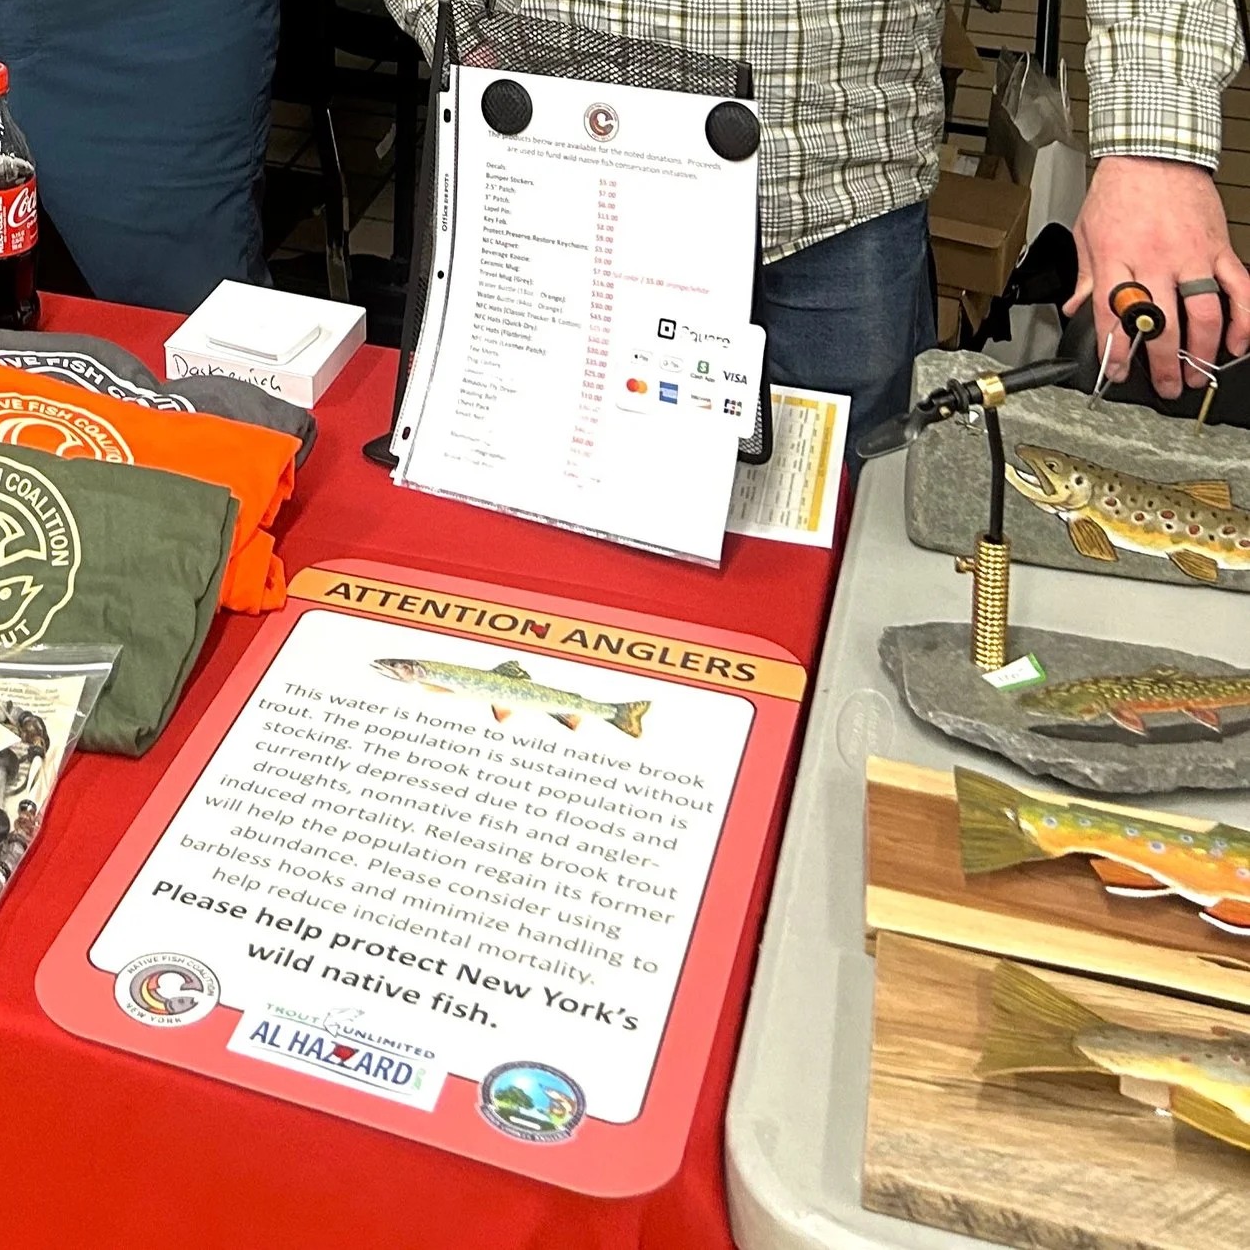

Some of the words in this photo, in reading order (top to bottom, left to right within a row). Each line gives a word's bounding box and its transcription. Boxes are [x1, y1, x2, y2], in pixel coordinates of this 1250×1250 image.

[28, 402, 73, 421] FISH
[722, 370, 747, 385] VISA
[5, 472, 69, 567] COALITION
[324, 582, 551, 639] ATTENTION
[560, 629, 757, 683] ANGLERS
[258, 698, 313, 720] trout.
[323, 711, 360, 730] The
[364, 724, 481, 758] population
[487, 749, 503, 764] is
[510, 755, 618, 790] sustained
[624, 780, 714, 812] without
[262, 720, 353, 751] stocking.
[363, 741, 400, 760] The
[406, 752, 470, 778] brook
[476, 769, 532, 792] trout
[538, 785, 663, 825] population
[670, 814, 689, 831] is
[284, 682, 322, 701] This
[330, 694, 389, 716] water
[394, 706, 409, 721] is
[415, 711, 476, 736] home
[483, 728, 504, 742] to
[512, 734, 557, 754] wild
[563, 746, 631, 771] native
[639, 762, 705, 789] brook
[219, 773, 307, 805] induced
[311, 796, 415, 834] mortality.
[424, 824, 534, 865] Releasing
[540, 852, 609, 883] brook
[617, 875, 678, 901] trout
[253, 761, 352, 795] droughts,
[360, 786, 472, 823] nonnative
[478, 813, 519, 835] fish
[526, 828, 570, 847] and
[576, 839, 660, 869] angler-
[255, 739, 351, 772] currently
[356, 758, 469, 799] depressed
[475, 791, 518, 811] due
[524, 804, 548, 818] to
[555, 809, 626, 839] floods
[632, 830, 678, 851] and
[179, 833, 271, 869] barbless
[278, 859, 346, 888] hooks
[351, 880, 397, 902] and
[402, 893, 510, 932] minimize
[517, 922, 624, 968] handling
[632, 955, 659, 974] to
[204, 794, 243, 813] will
[247, 803, 295, 826] help
[301, 817, 337, 836] the
[342, 829, 467, 870] population
[474, 863, 547, 891] regain
[554, 881, 583, 900] its
[590, 890, 676, 925] former
[229, 825, 359, 867] abundance.
[367, 858, 442, 889] Please
[448, 881, 552, 918] consider
[557, 910, 623, 941] using
[126, 955, 159, 975] NATIVE
[161, 955, 186, 966] FISH
[185, 960, 217, 998] COALITION
[151, 880, 248, 919] Please
[255, 907, 323, 942] help
[329, 931, 448, 976] protect
[455, 964, 533, 1000] New
[543, 986, 639, 1031] York's
[211, 867, 261, 892] help
[267, 883, 347, 914] reduce
[352, 904, 472, 949] incidental
[477, 941, 596, 987] mortality.
[125, 1002, 148, 1021] NEW
[150, 1015, 183, 1025] YORK
[247, 942, 315, 974] wild
[321, 963, 421, 1003] native
[431, 991, 498, 1029] fish.
[265, 1001, 320, 1025] TROUT
[341, 1025, 437, 1060] UNLIMITED
[250, 1020, 282, 1050] AL
[287, 1028, 416, 1087] HAZZARD
